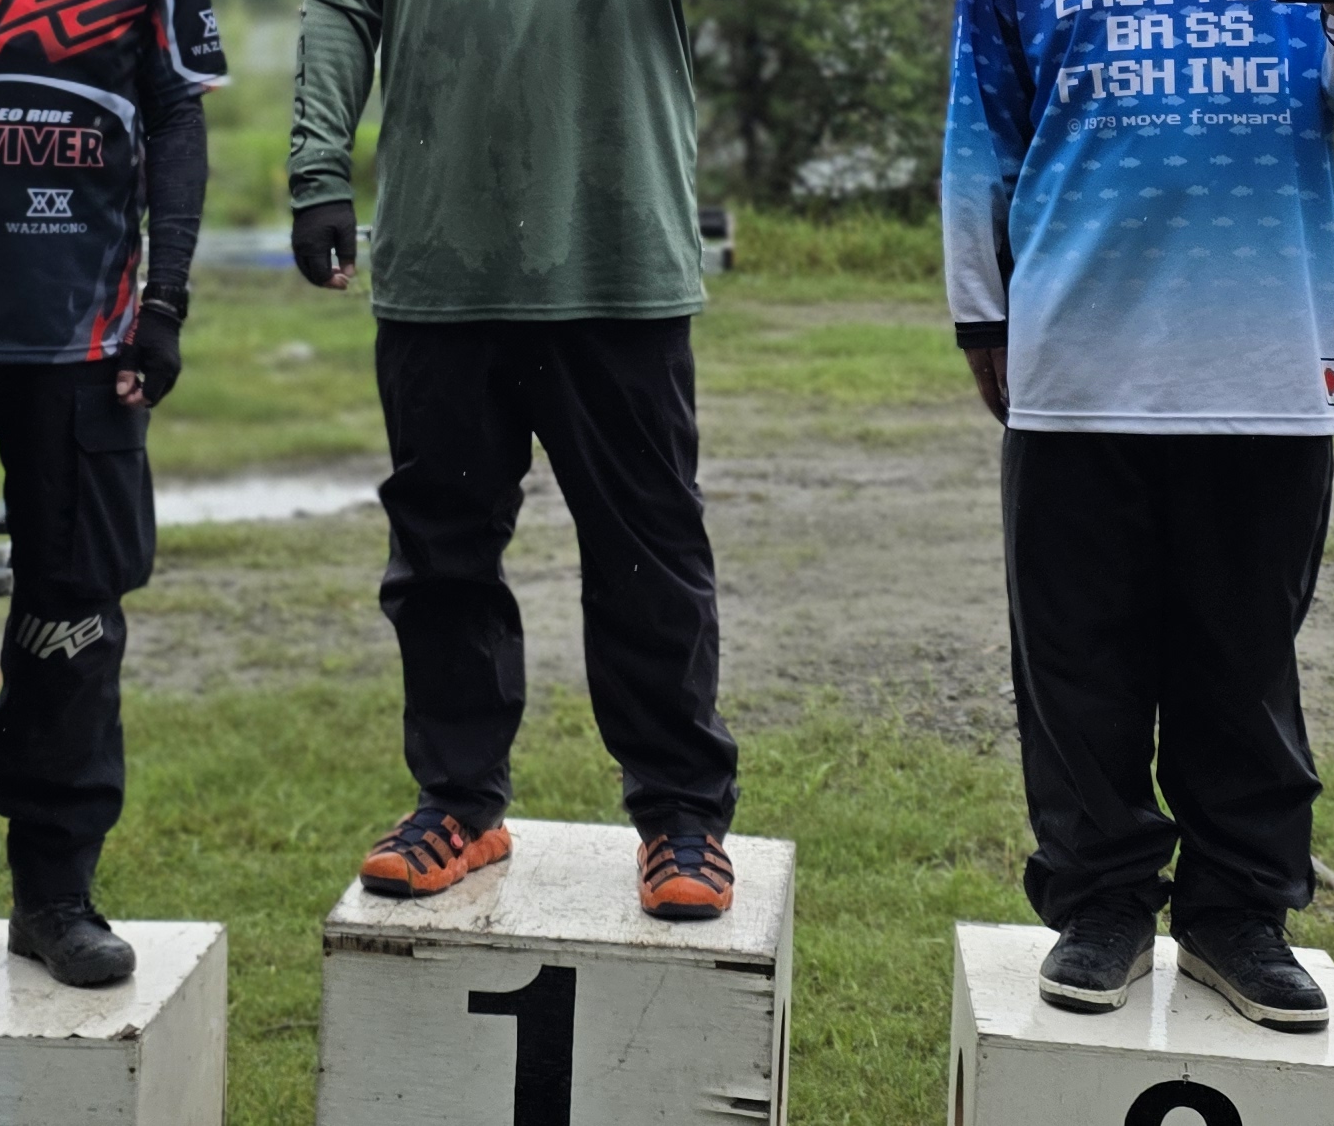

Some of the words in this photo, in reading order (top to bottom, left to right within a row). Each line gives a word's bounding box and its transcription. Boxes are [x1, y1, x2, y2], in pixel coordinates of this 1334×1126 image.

[1106, 11, 1254, 52] BASS
[1057, 57, 1290, 104] FISHING!
[25, 109, 74, 123] RIDE
[1084, 116, 1116, 130] 1979
[5, 222, 88, 235] WAZAMONO
[468, 964, 577, 1126] 1
